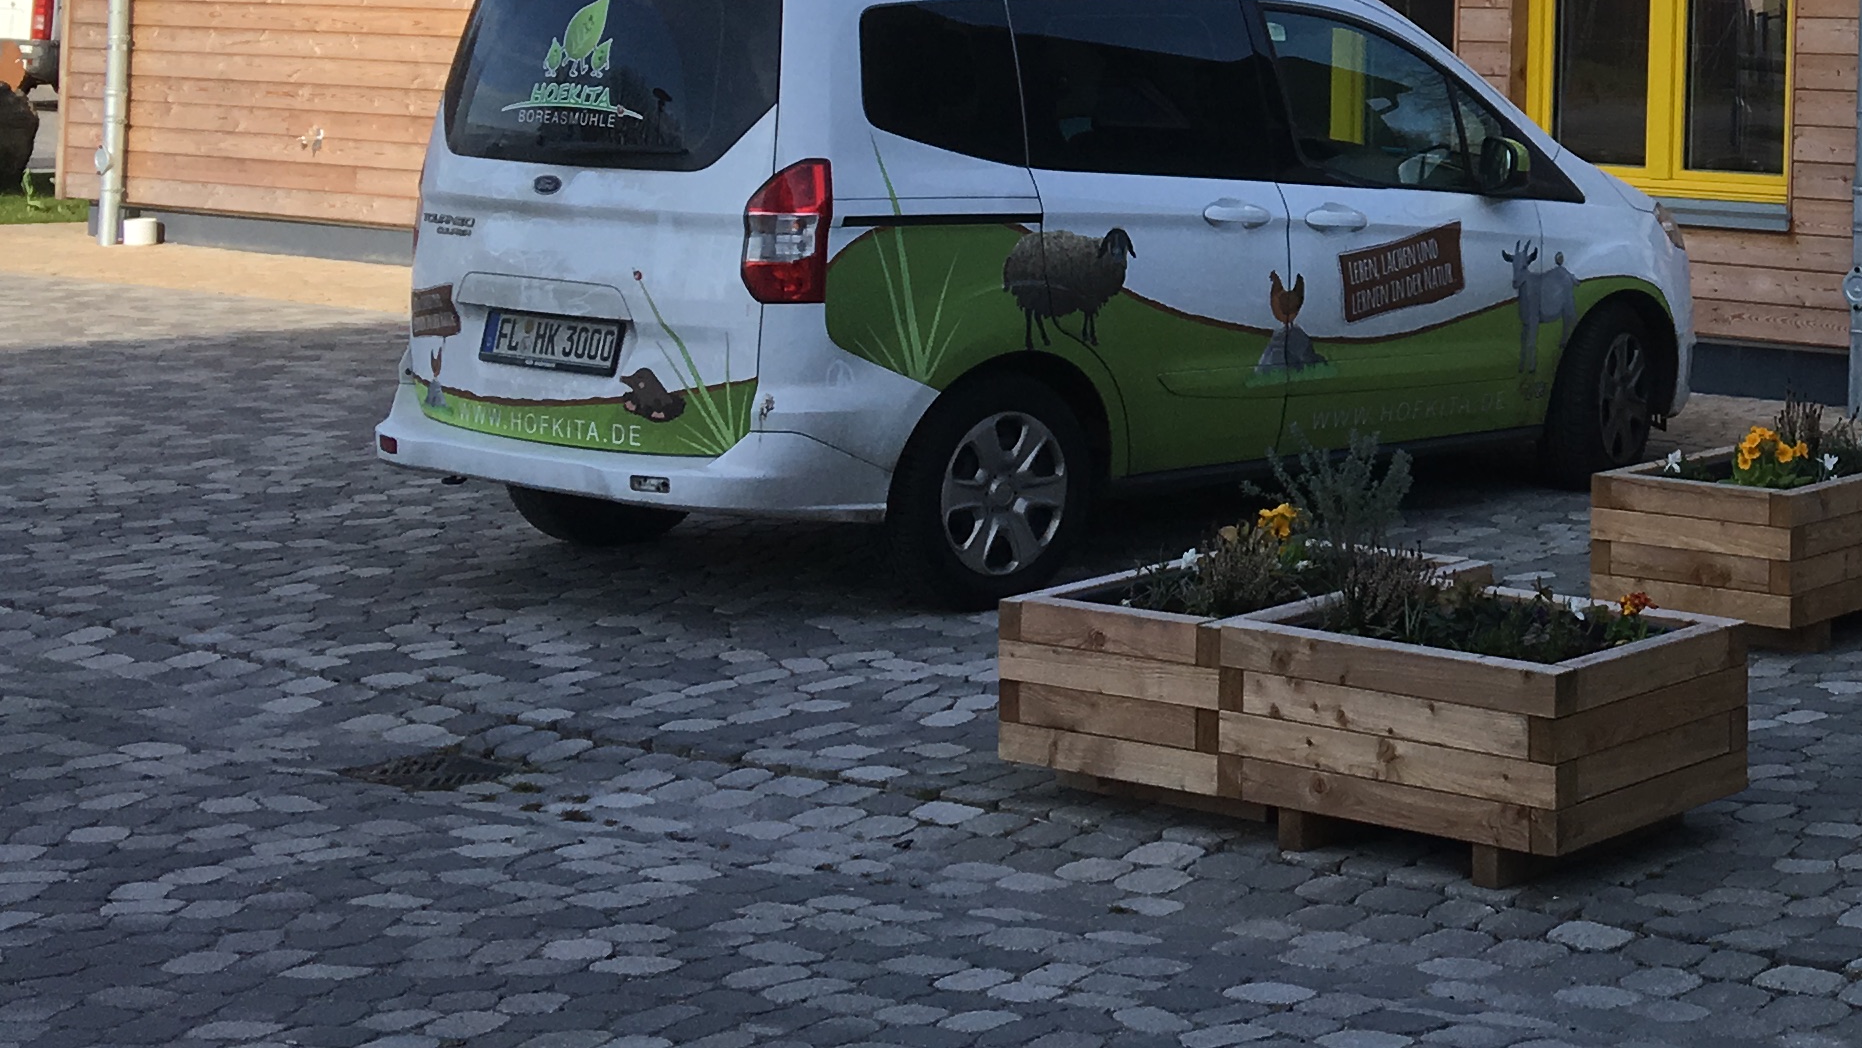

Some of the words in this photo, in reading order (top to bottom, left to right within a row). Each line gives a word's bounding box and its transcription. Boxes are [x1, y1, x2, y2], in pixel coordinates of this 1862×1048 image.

[518, 109, 616, 128] BOREASMÜHLE
[1380, 244, 1417, 274] LACHEN
[1416, 238, 1439, 263] UND
[1352, 284, 1389, 315] LERNEN
[1390, 278, 1405, 302] IN
[1406, 272, 1424, 297] DER
[496, 318, 519, 352] FL
[532, 321, 562, 356] HK
[561, 325, 616, 362] 3000
[458, 403, 642, 447] WWW.HOFKITA.DE
